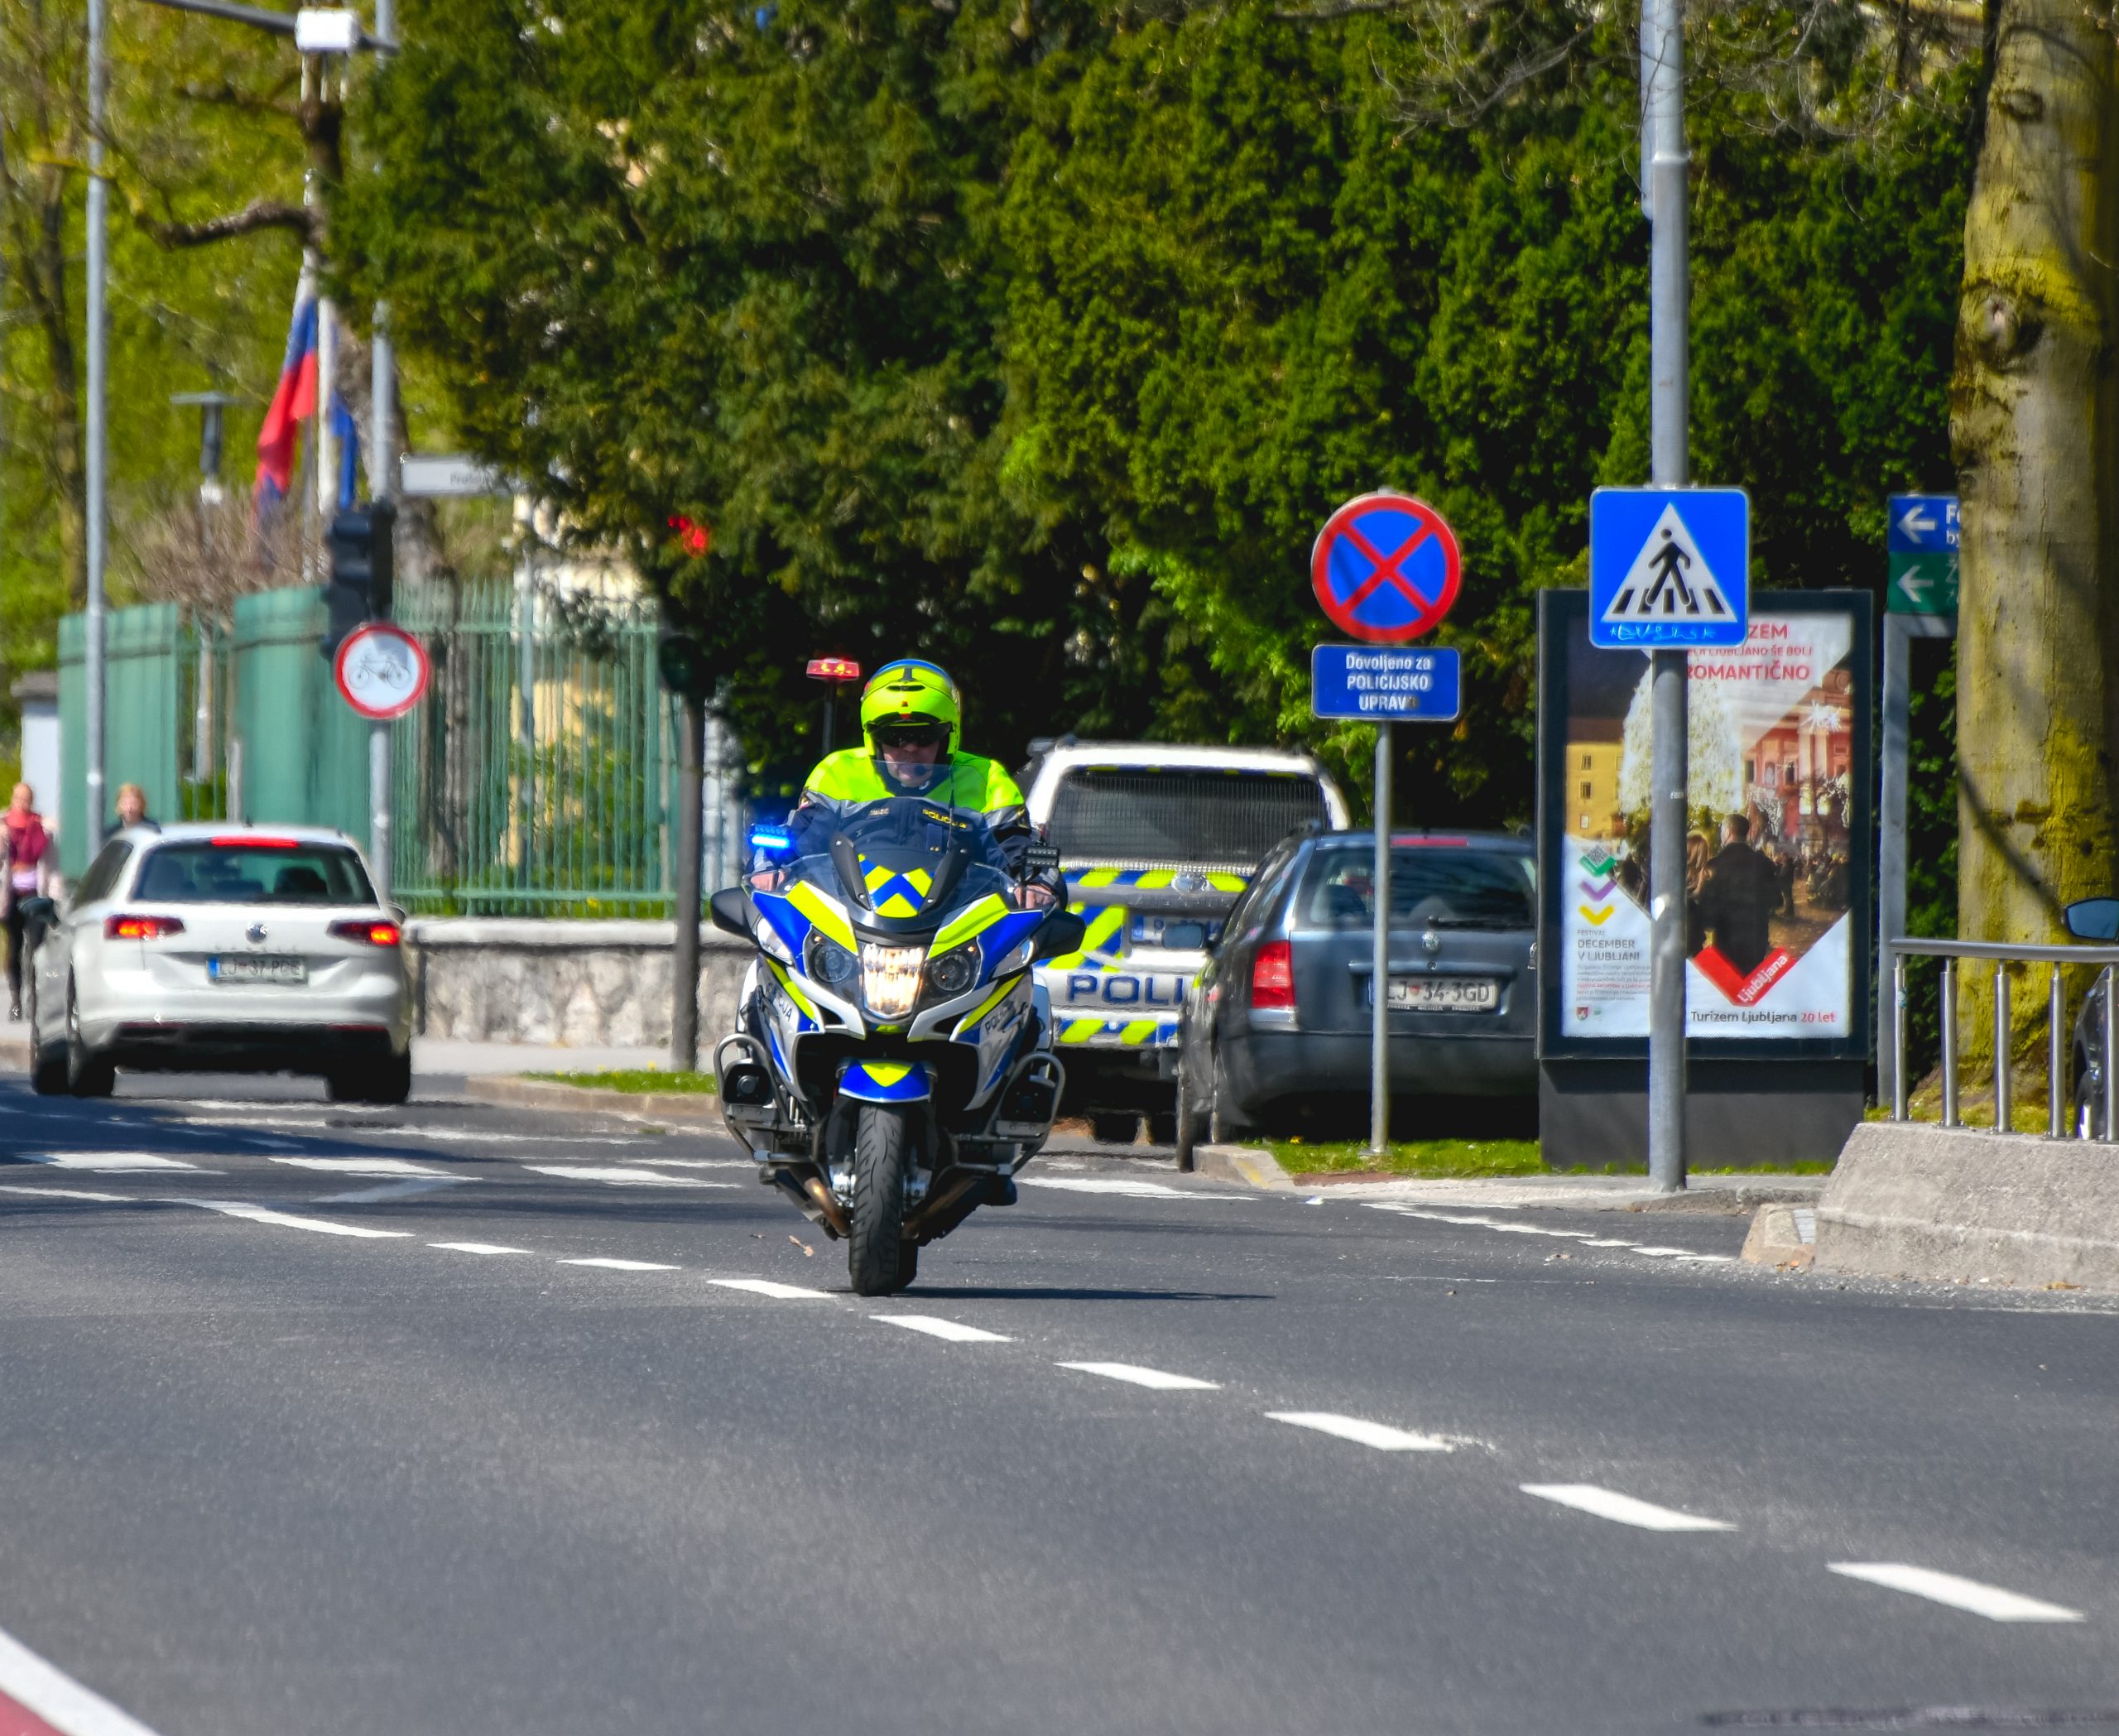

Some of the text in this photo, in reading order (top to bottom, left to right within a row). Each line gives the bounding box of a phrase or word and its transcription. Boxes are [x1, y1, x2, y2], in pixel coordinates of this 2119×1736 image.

[1748, 623, 1788, 639] ZEM
[1346, 655, 1430, 671] Dovoljeno za
[1347, 676, 1428, 690] POLICIJSKO
[1359, 695, 1417, 710] UPRAV
[1578, 939, 1636, 950] DECEMBER
[1578, 951, 1640, 961] V LJUBLJANI
[1737, 954, 1789, 1003] Ljubljana
[1067, 974, 1184, 1006] POLI
[1691, 1011, 1836, 1024] Turizem Ljubljana 20 let
